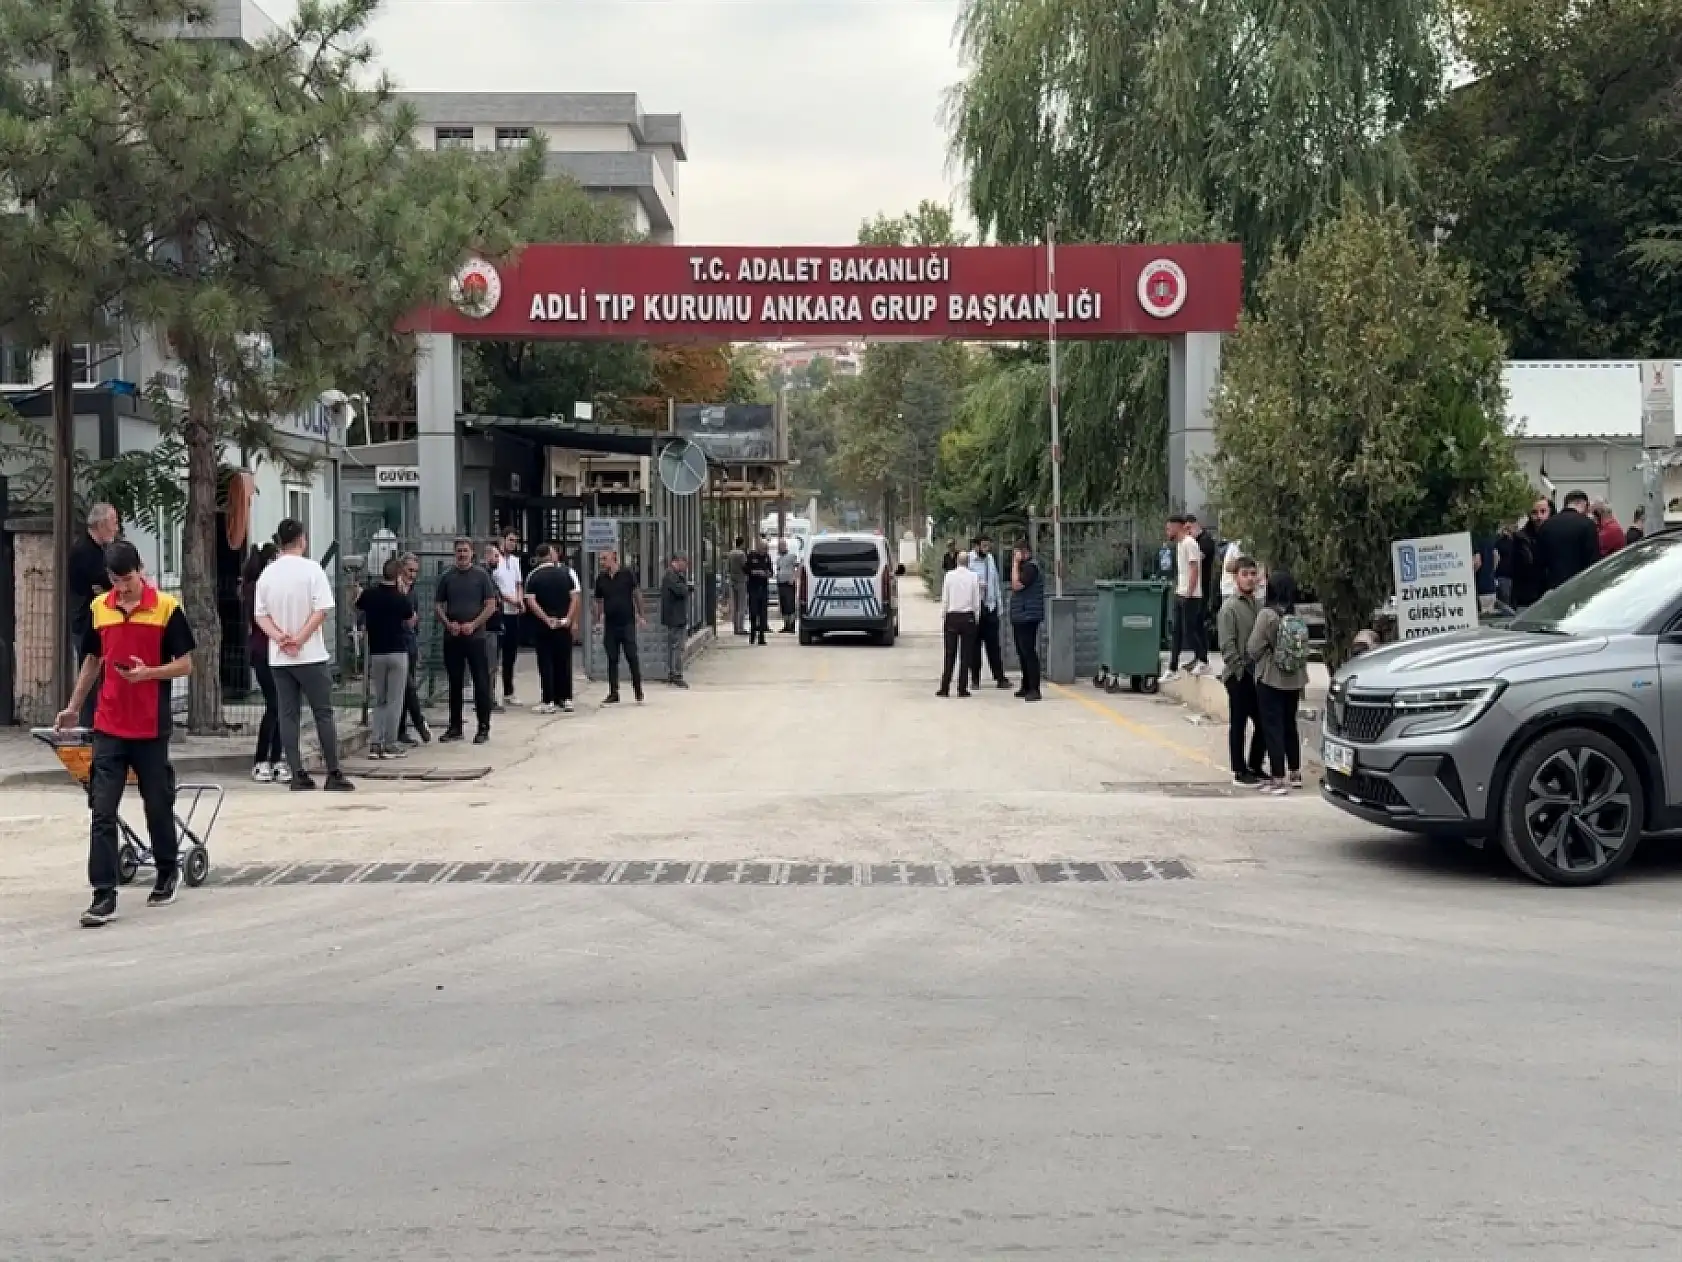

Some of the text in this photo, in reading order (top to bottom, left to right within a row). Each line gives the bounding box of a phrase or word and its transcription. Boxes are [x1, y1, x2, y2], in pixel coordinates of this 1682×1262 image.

[689, 252, 949, 281] T.C. ADALET BAKANLIĞI
[529, 287, 1102, 326] ADLİ TIP KURUMU ANKARA GRUP BAŞKANLIĞI
[1448, 606, 1464, 617] ve
